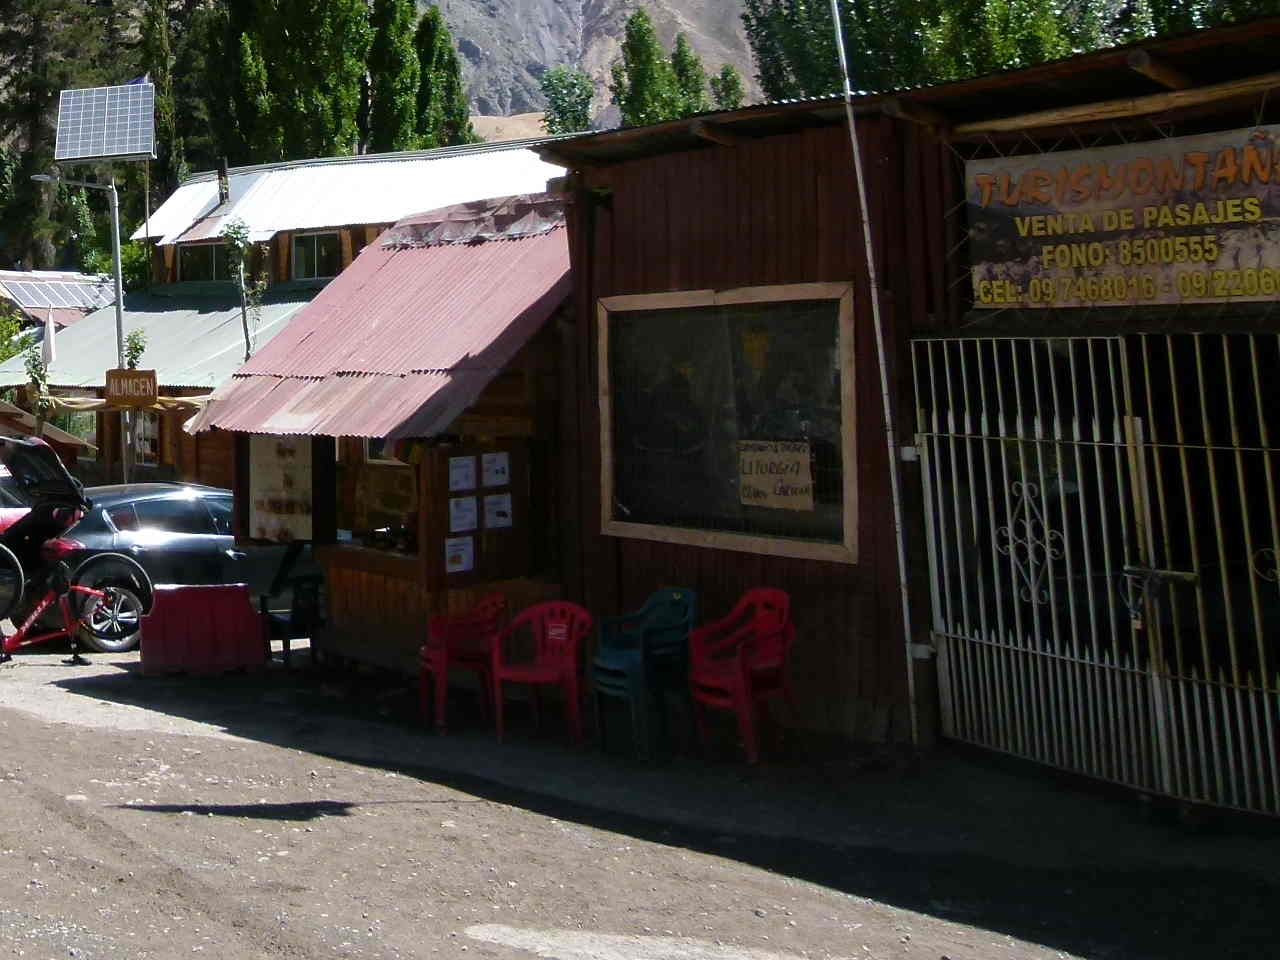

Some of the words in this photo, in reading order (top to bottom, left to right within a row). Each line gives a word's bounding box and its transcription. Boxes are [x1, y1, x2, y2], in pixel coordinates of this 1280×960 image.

[1014, 211, 1096, 237] VENTA
[1104, 207, 1135, 231] DE
[1143, 197, 1263, 229] PASAJES
[1041, 241, 1110, 269] FONO:
[1118, 235, 1220, 265] 8500555
[979, 279, 1022, 304] CEL:
